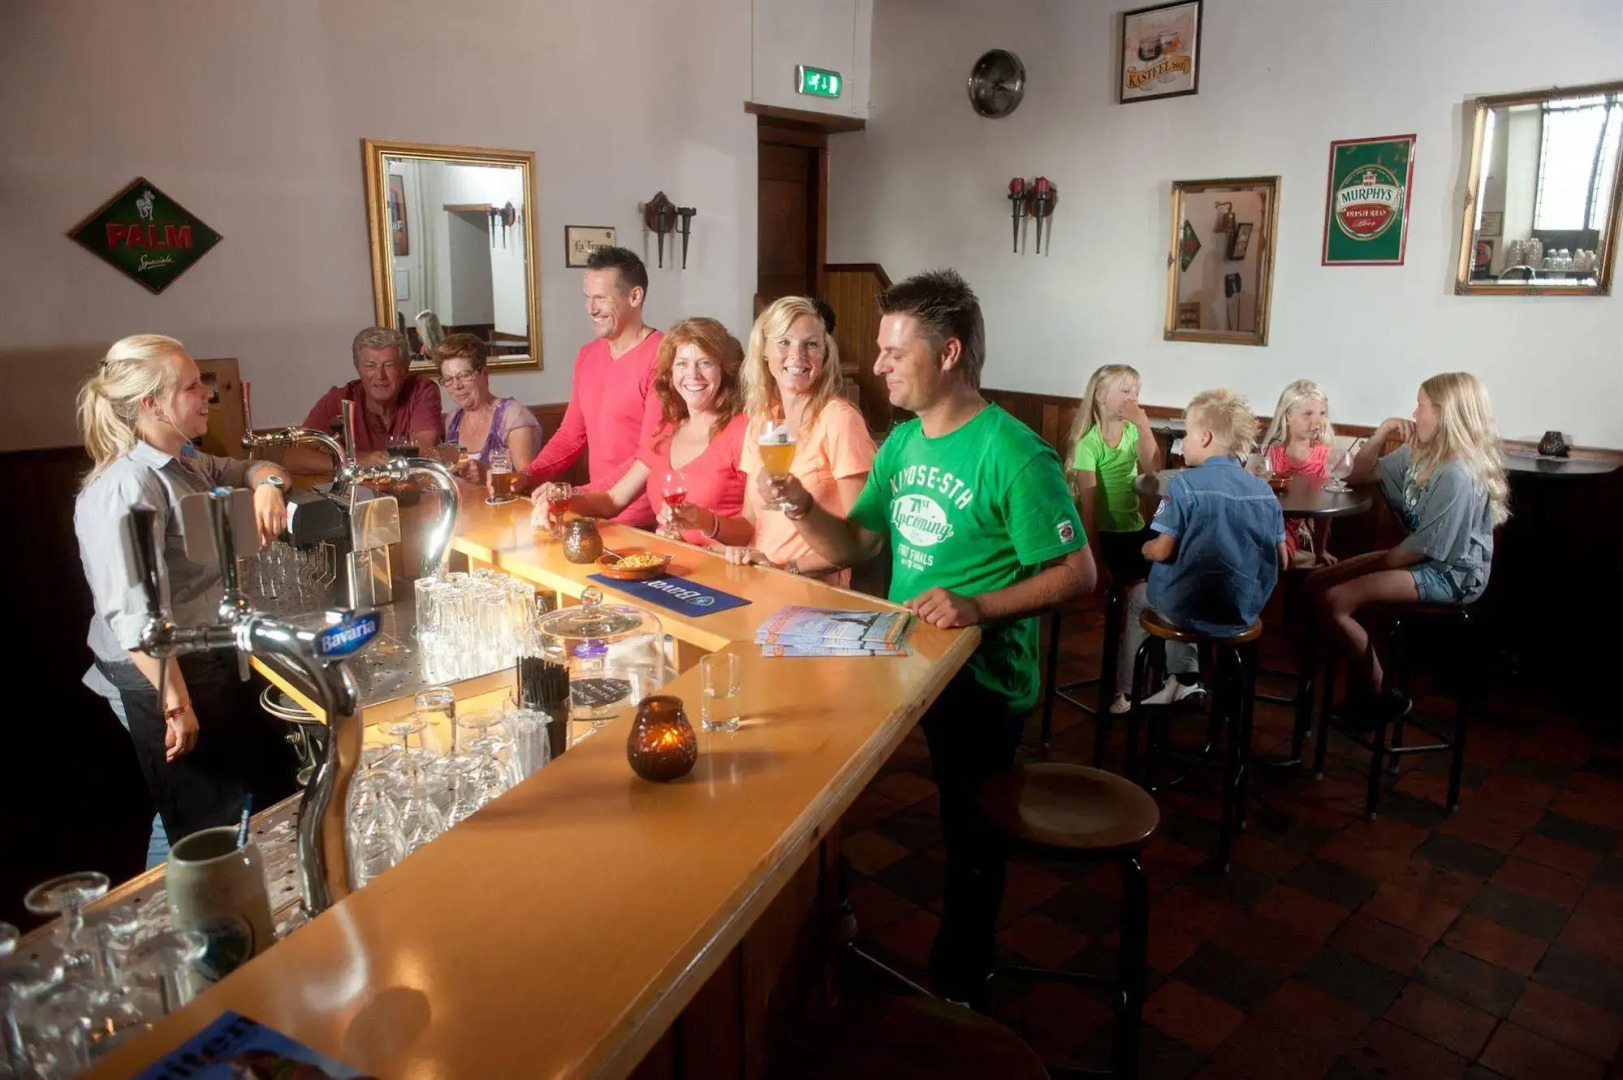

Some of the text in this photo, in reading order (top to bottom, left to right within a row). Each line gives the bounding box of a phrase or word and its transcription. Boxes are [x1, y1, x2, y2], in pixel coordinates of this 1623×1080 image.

[1369, 209, 1386, 217] RED
[106, 223, 193, 249] PALM
[641, 580, 701, 600] Bava
[321, 619, 376, 652] Bavaria
